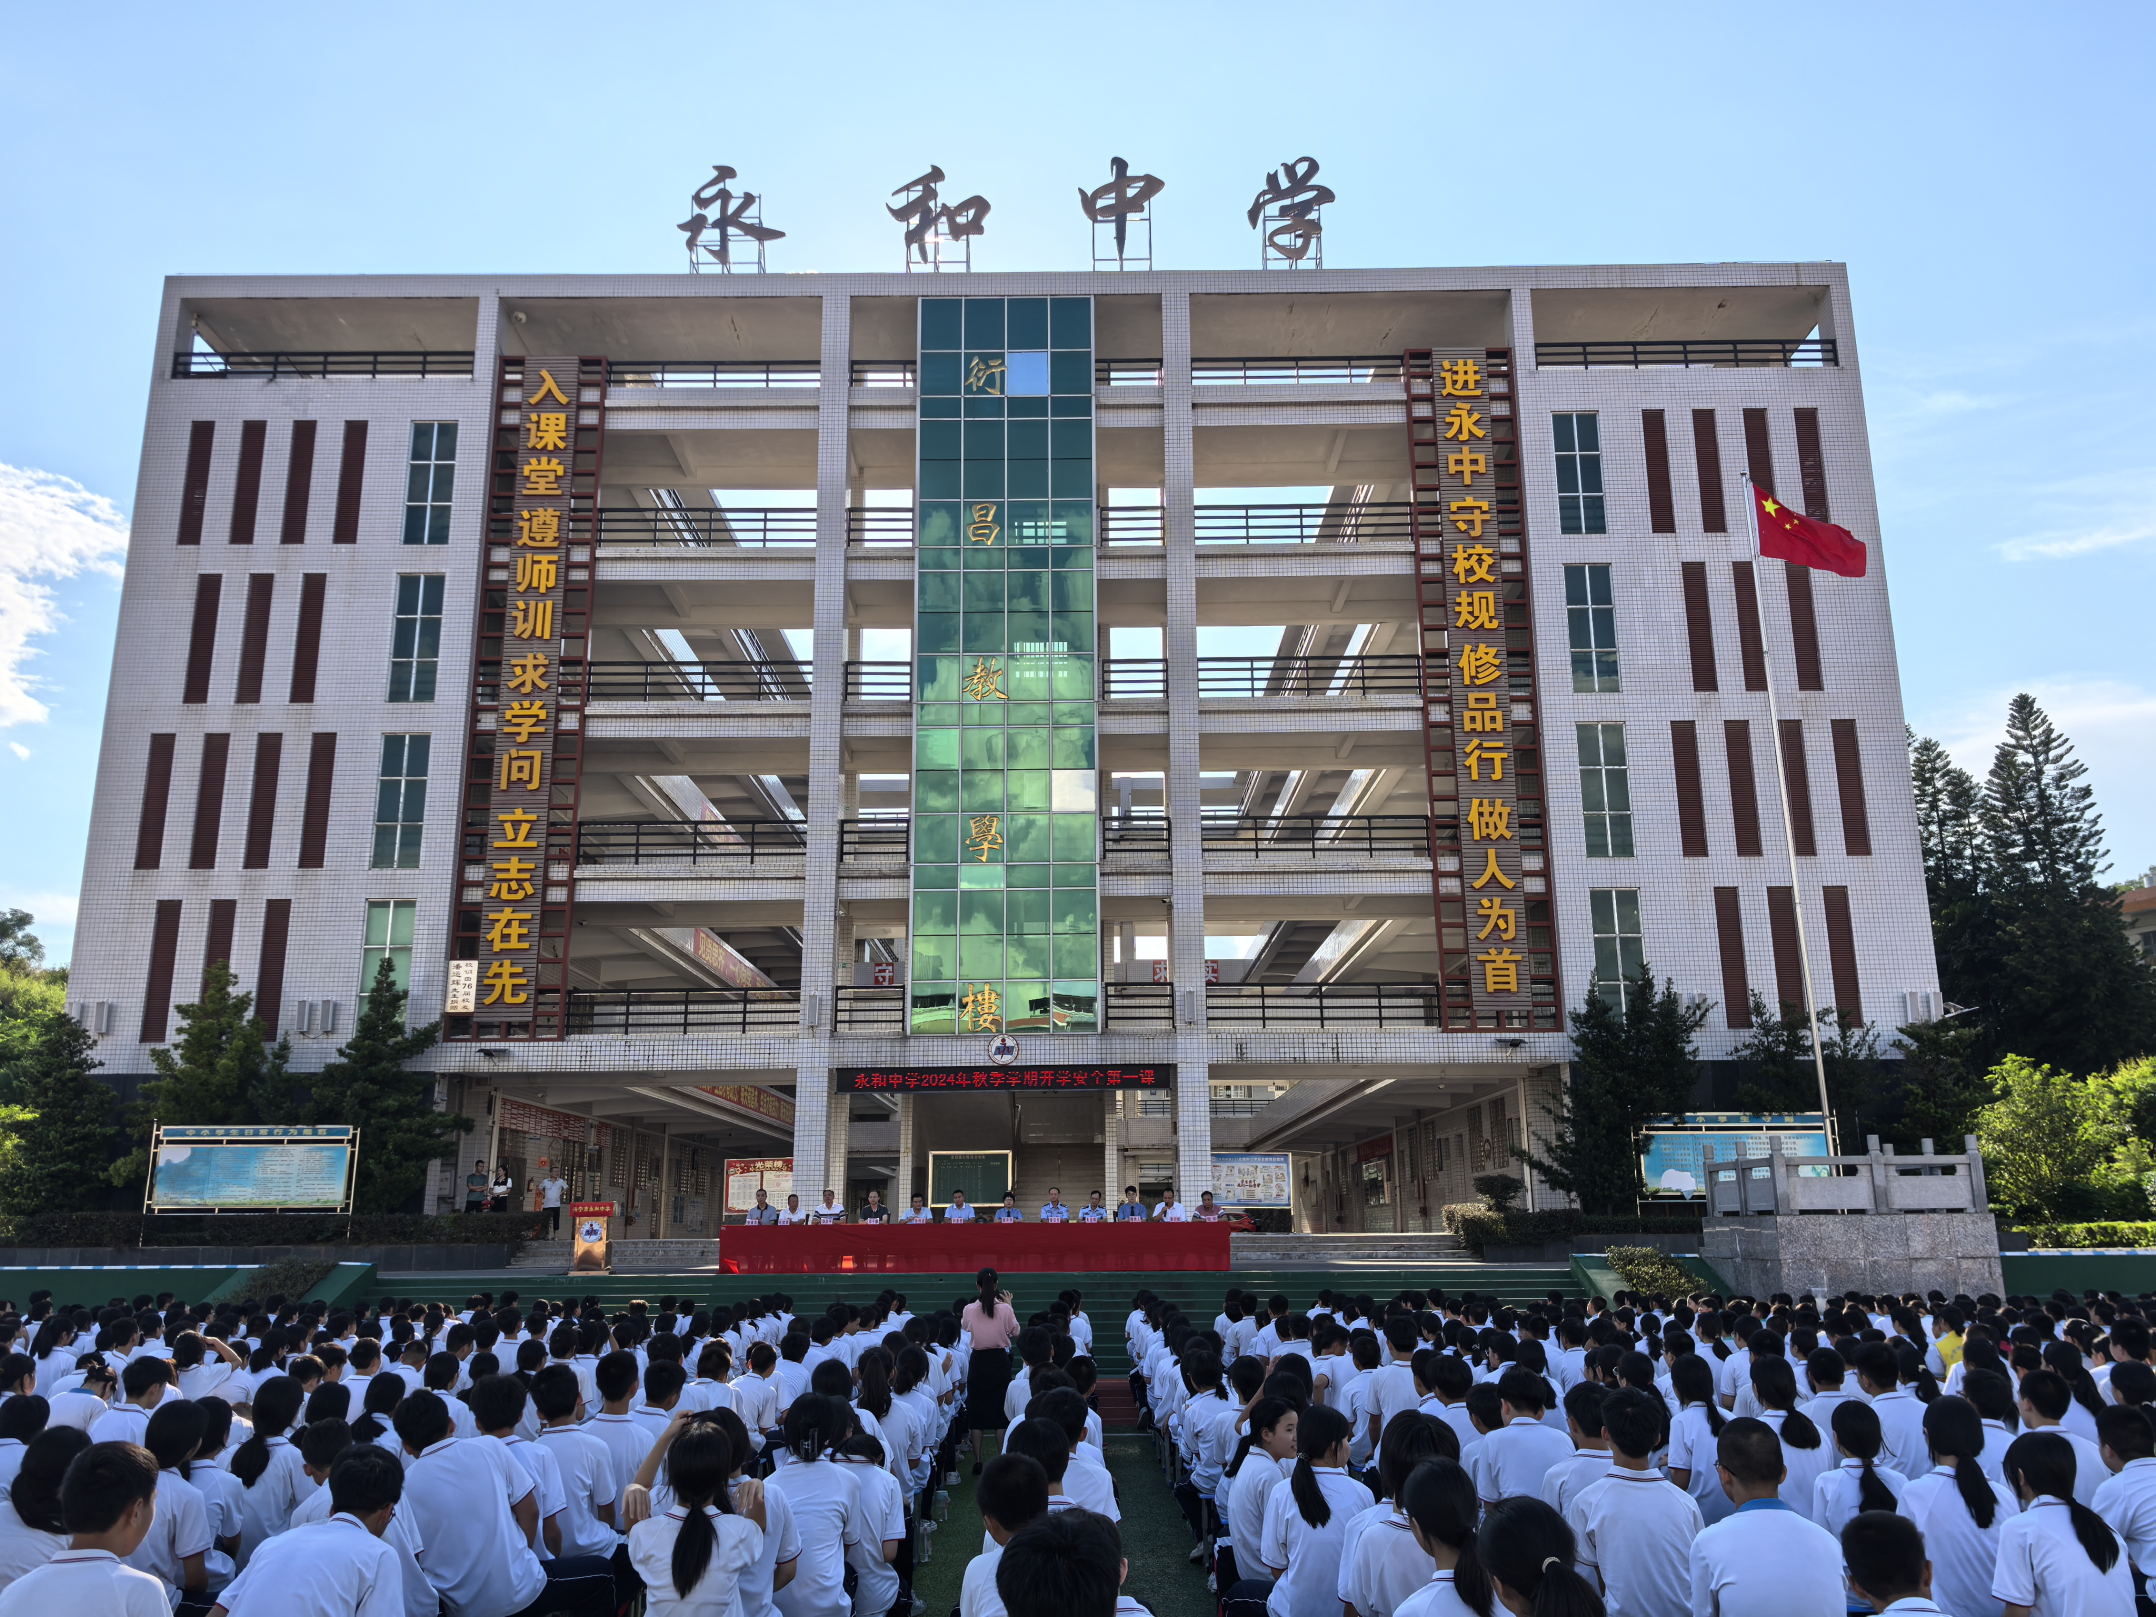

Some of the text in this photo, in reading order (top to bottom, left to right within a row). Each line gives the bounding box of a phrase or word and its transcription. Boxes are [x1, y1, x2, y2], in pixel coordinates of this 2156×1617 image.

[677, 156, 1336, 264] 永和中学
[482, 369, 570, 1005] 入课堂遵师训求学问立志在先
[959, 355, 1010, 1034] 衍昌教學樓
[1440, 359, 1522, 994] 进永中守校规修品行做人为首
[854, 1068, 1156, 1090] 永和中学2024年秋季学期开学安全第一课
[874, 963, 894, 986] 守
